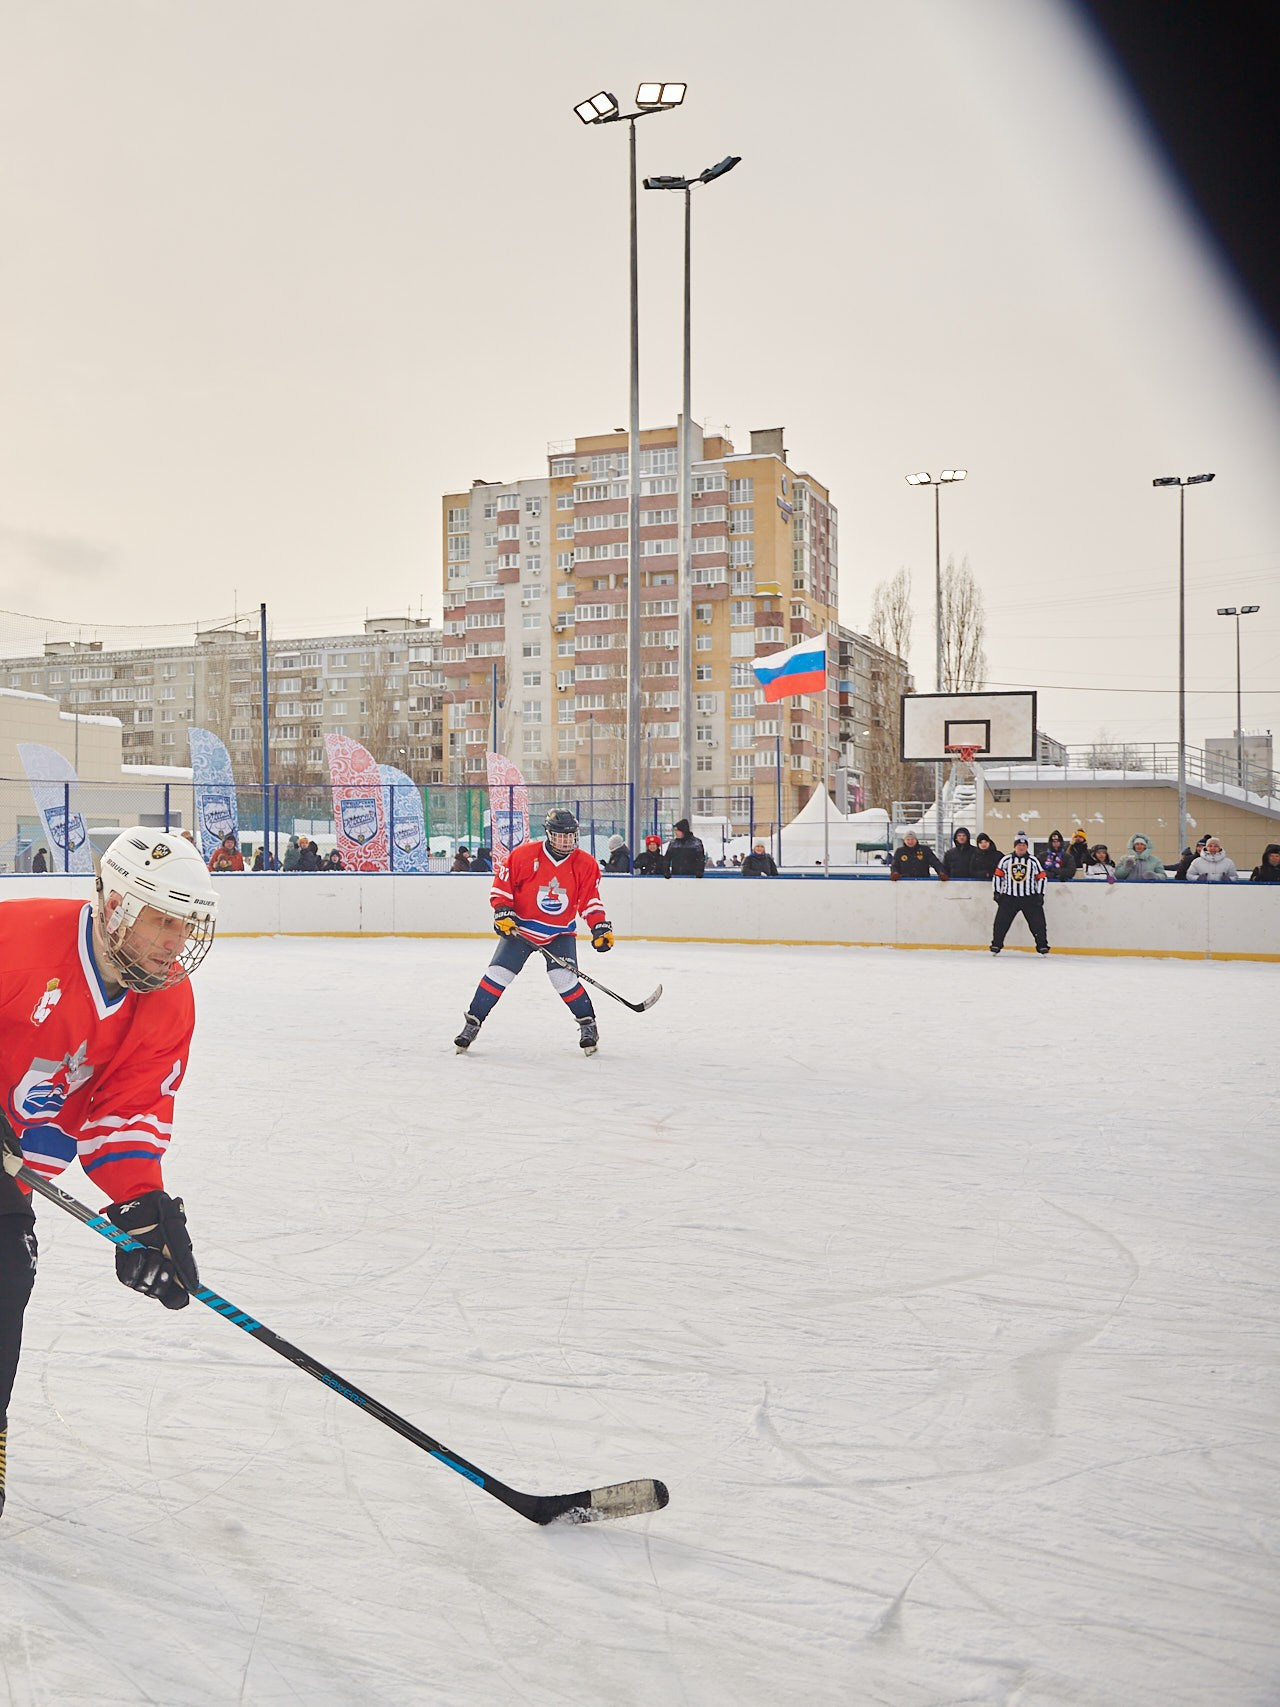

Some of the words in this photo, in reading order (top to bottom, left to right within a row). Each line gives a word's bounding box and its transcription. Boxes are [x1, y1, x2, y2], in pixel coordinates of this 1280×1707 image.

[106, 858, 130, 877] BAUER
[498, 865, 510, 882] 87
[193, 898, 215, 907] BAUER
[321, 1374, 367, 1406] COVERT
